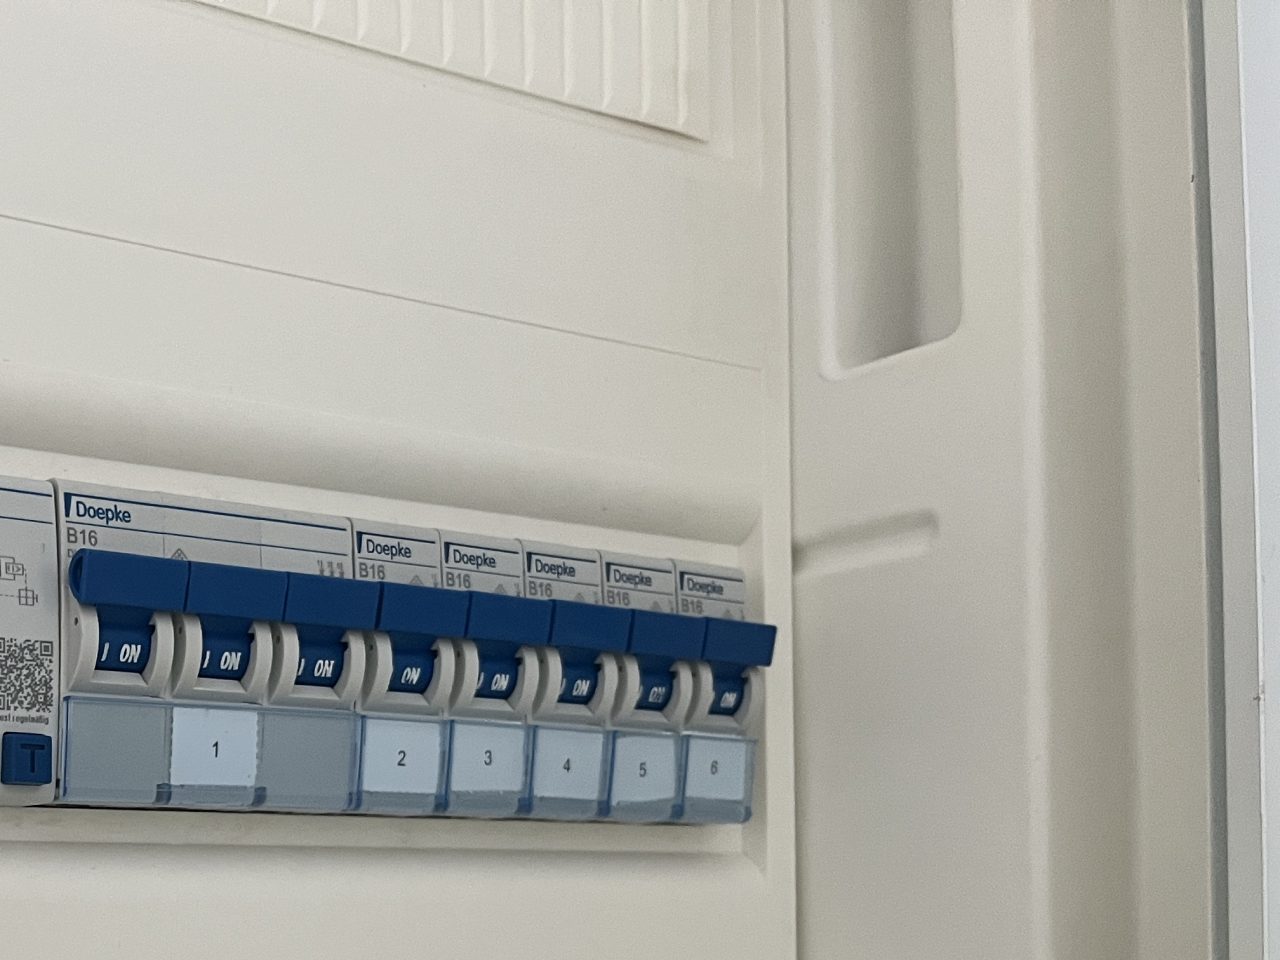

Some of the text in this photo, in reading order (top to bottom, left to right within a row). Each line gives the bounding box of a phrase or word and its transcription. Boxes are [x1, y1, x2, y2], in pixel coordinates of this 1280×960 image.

[75, 500, 132, 525] Doepke
[66, 526, 98, 547] B16
[366, 538, 412, 560] Doepke
[453, 549, 496, 569] Doepke
[535, 558, 576, 578] Doepke
[358, 563, 385, 580] B16
[446, 572, 470, 588] B16
[613, 568, 652, 588] Doepke
[529, 581, 553, 597] B16
[686, 578, 724, 596] Doepke
[607, 591, 630, 606] B16
[681, 599, 703, 614] B16
[119, 643, 142, 664] ON
[220, 651, 242, 671] ON
[313, 659, 335, 678] ON
[401, 667, 420, 685] ON
[490, 673, 510, 692] ON
[573, 679, 590, 697] ON
[649, 687, 666, 703] ON
[721, 692, 737, 707] ON
[212, 740, 219, 758] 1
[484, 750, 493, 766] 3
[21, 743, 45, 774] T
[397, 750, 407, 767] 2
[563, 758, 571, 773] 4
[639, 763, 647, 778] 5
[710, 761, 718, 775] 6
